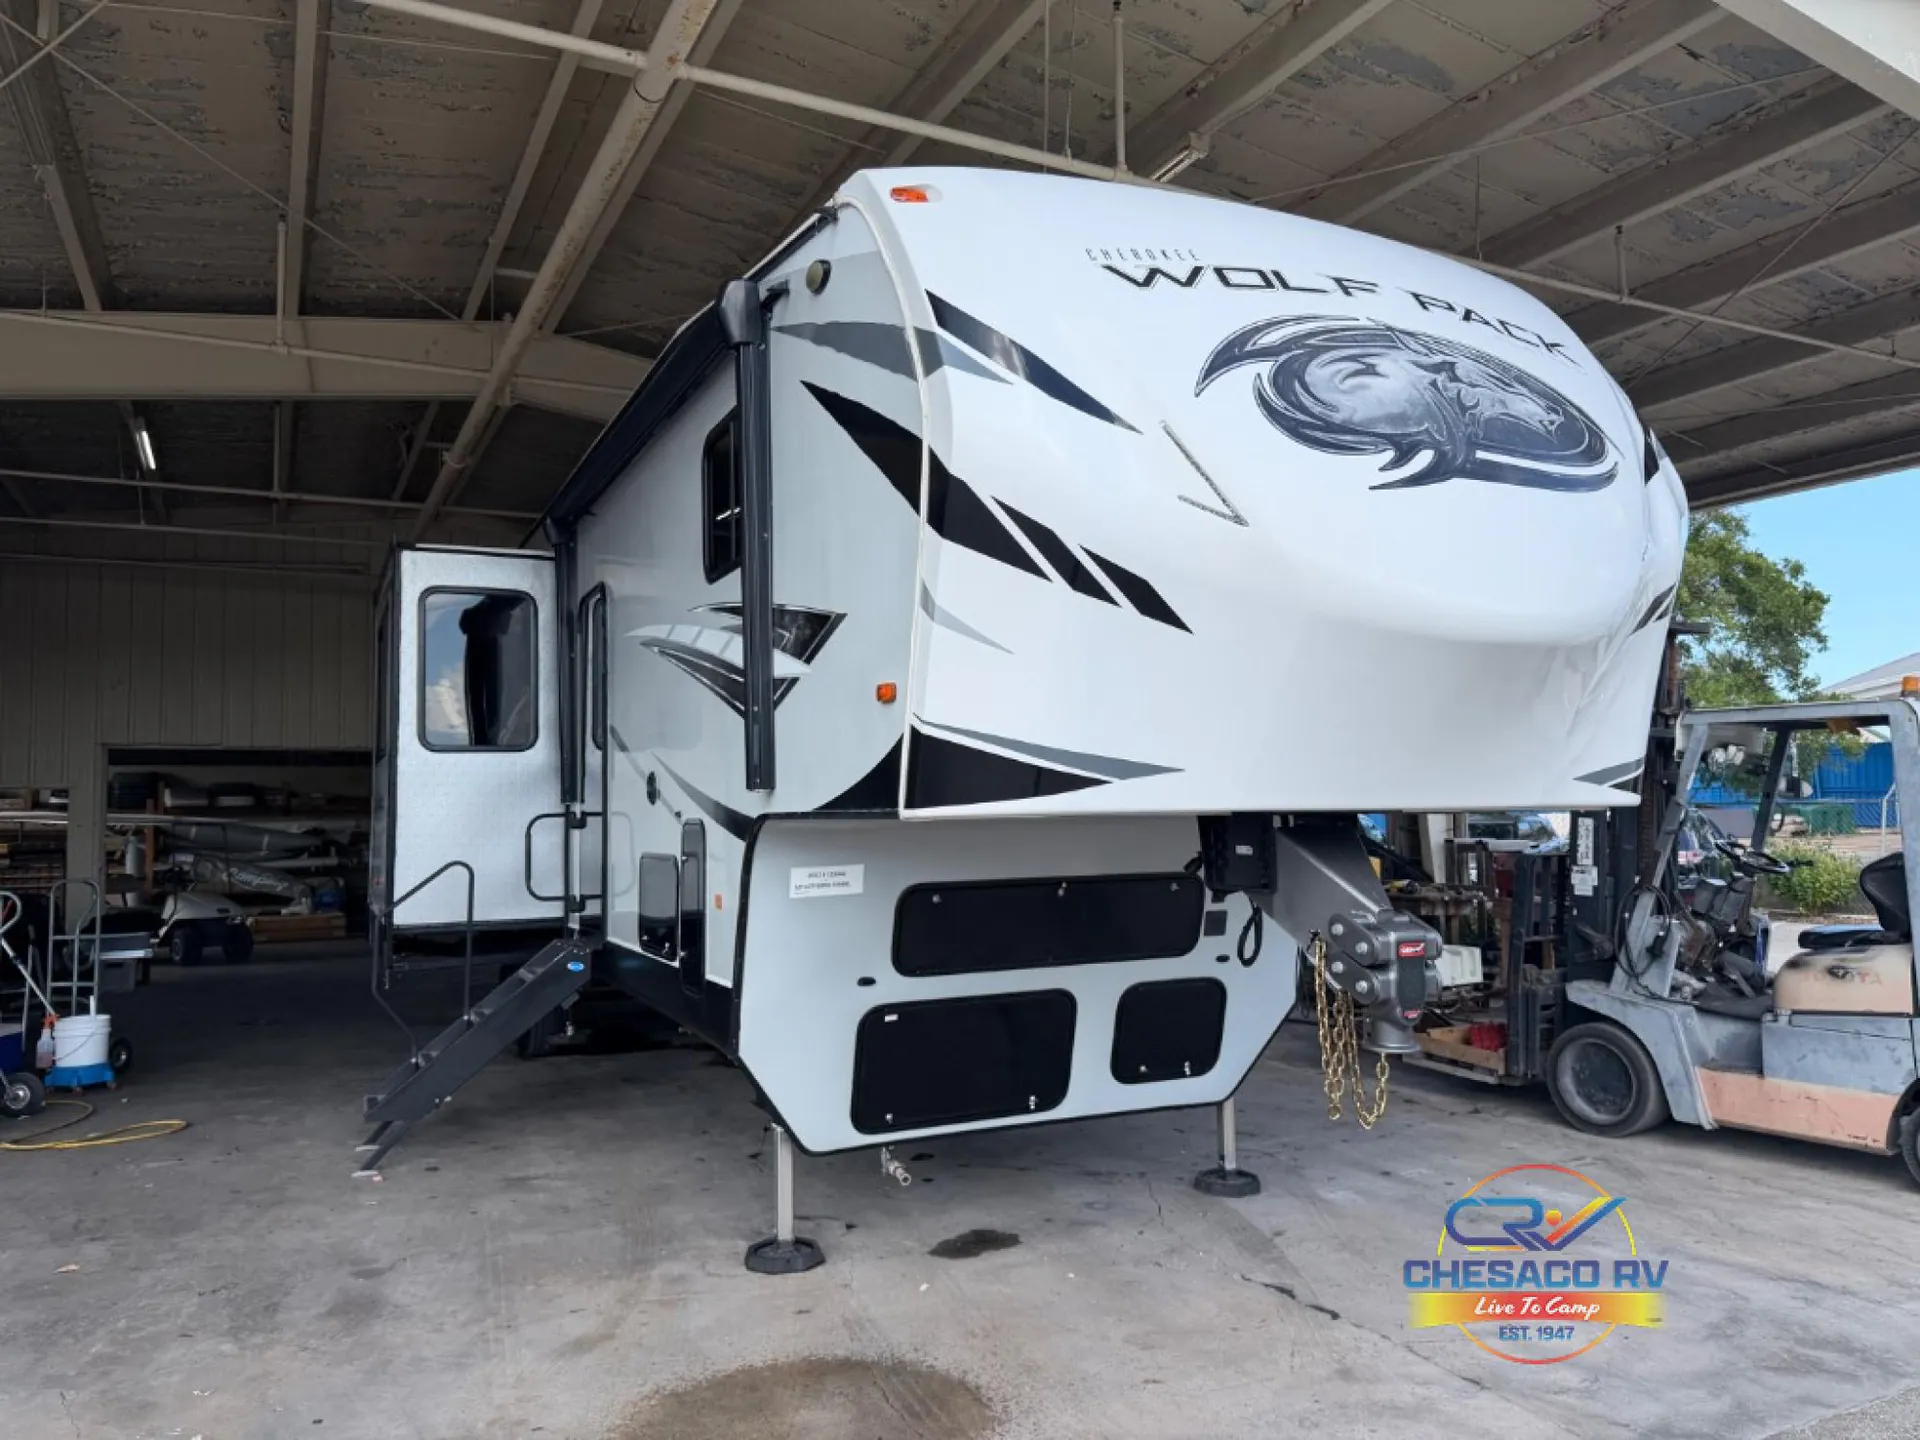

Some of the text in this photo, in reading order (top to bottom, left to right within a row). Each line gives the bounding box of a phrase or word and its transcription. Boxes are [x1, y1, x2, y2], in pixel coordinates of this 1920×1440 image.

[1085, 248, 1201, 261] CHEROKEE
[1100, 264, 1584, 369] WOLF PACK
